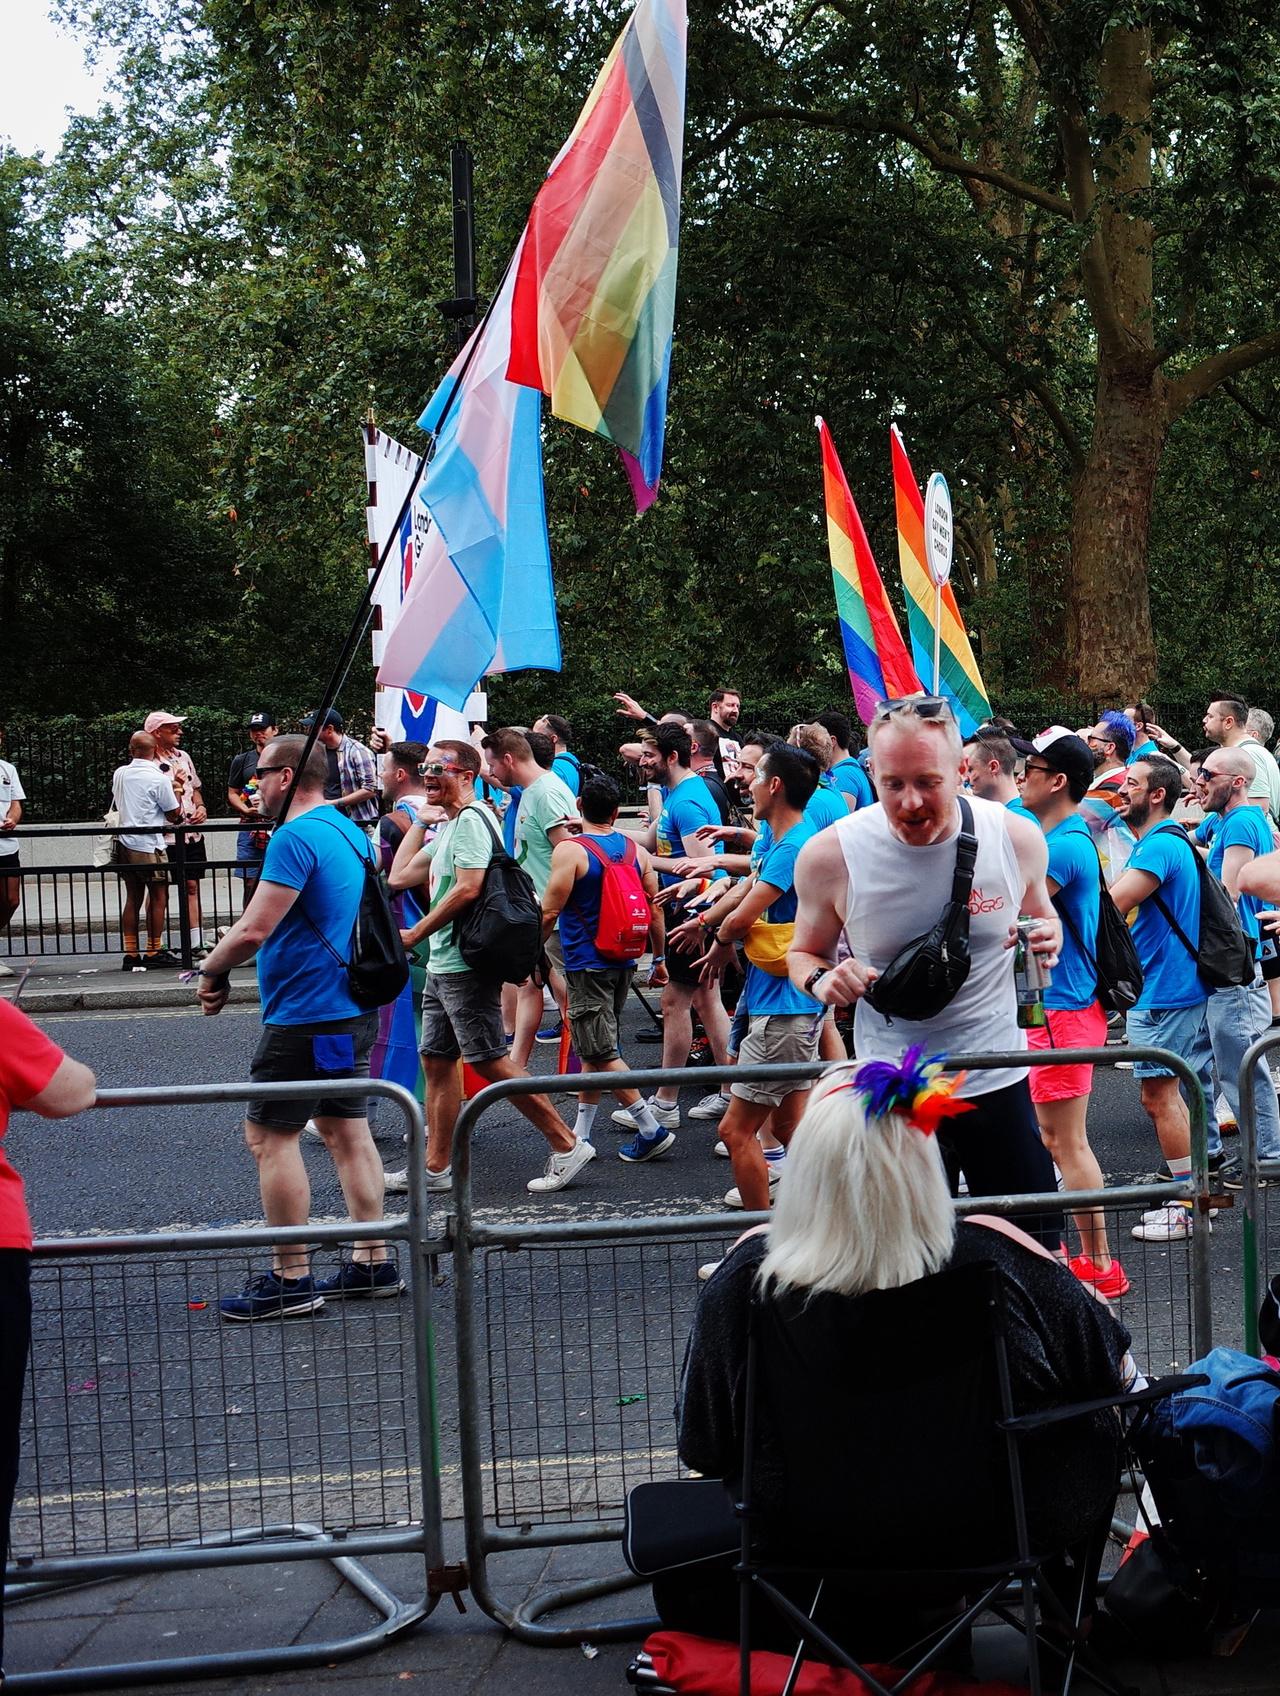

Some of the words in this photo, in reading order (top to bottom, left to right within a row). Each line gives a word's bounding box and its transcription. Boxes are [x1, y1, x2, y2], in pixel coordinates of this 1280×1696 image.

[414, 505, 431, 534] Lond
[935, 501, 948, 523] LONDON
[934, 538, 947, 558] CHORUS
[970, 896, 1004, 915] DERS
